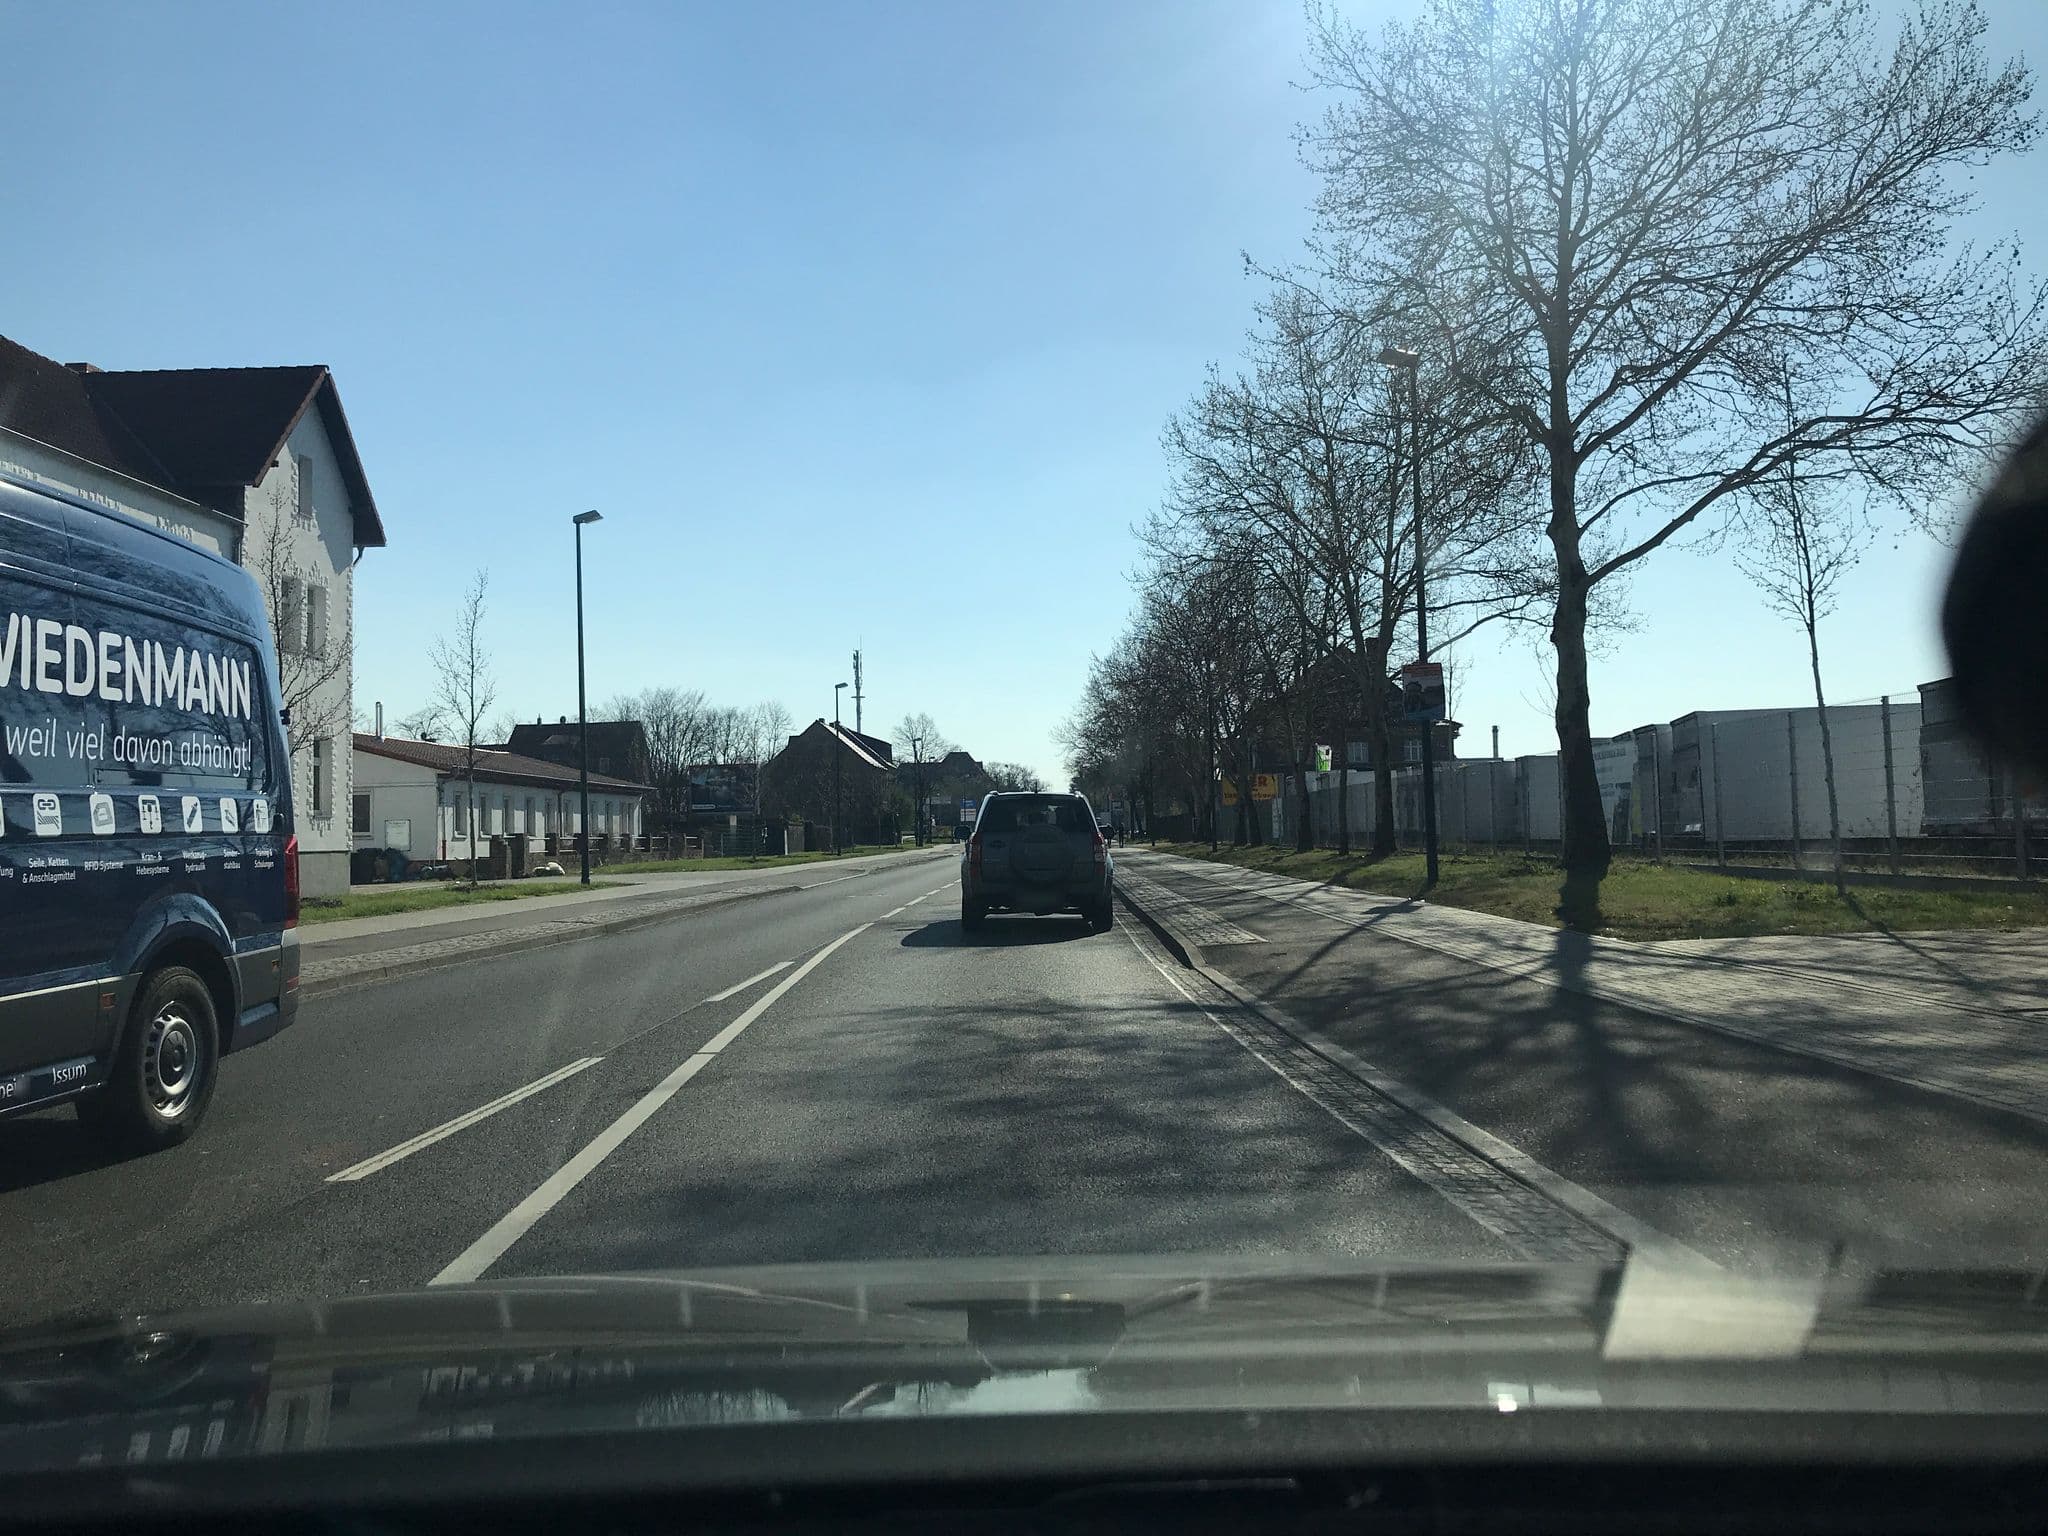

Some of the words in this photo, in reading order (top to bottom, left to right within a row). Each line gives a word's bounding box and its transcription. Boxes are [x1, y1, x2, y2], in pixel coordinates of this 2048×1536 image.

[6, 718, 56, 757] weil
[66, 722, 104, 761] viel
[113, 726, 173, 766] davon
[180, 733, 252, 778] abhängt!
[28, 857, 47, 868] Seile,
[47, 857, 70, 867] Ketten
[84, 861, 99, 871] RFID
[99, 860, 124, 872] Systeme
[22, 873, 28, 883] &
[29, 870, 76, 883] Anschlagmittel
[136, 866, 170, 876] Hebesysteme
[52, 1064, 87, 1085] Issum
